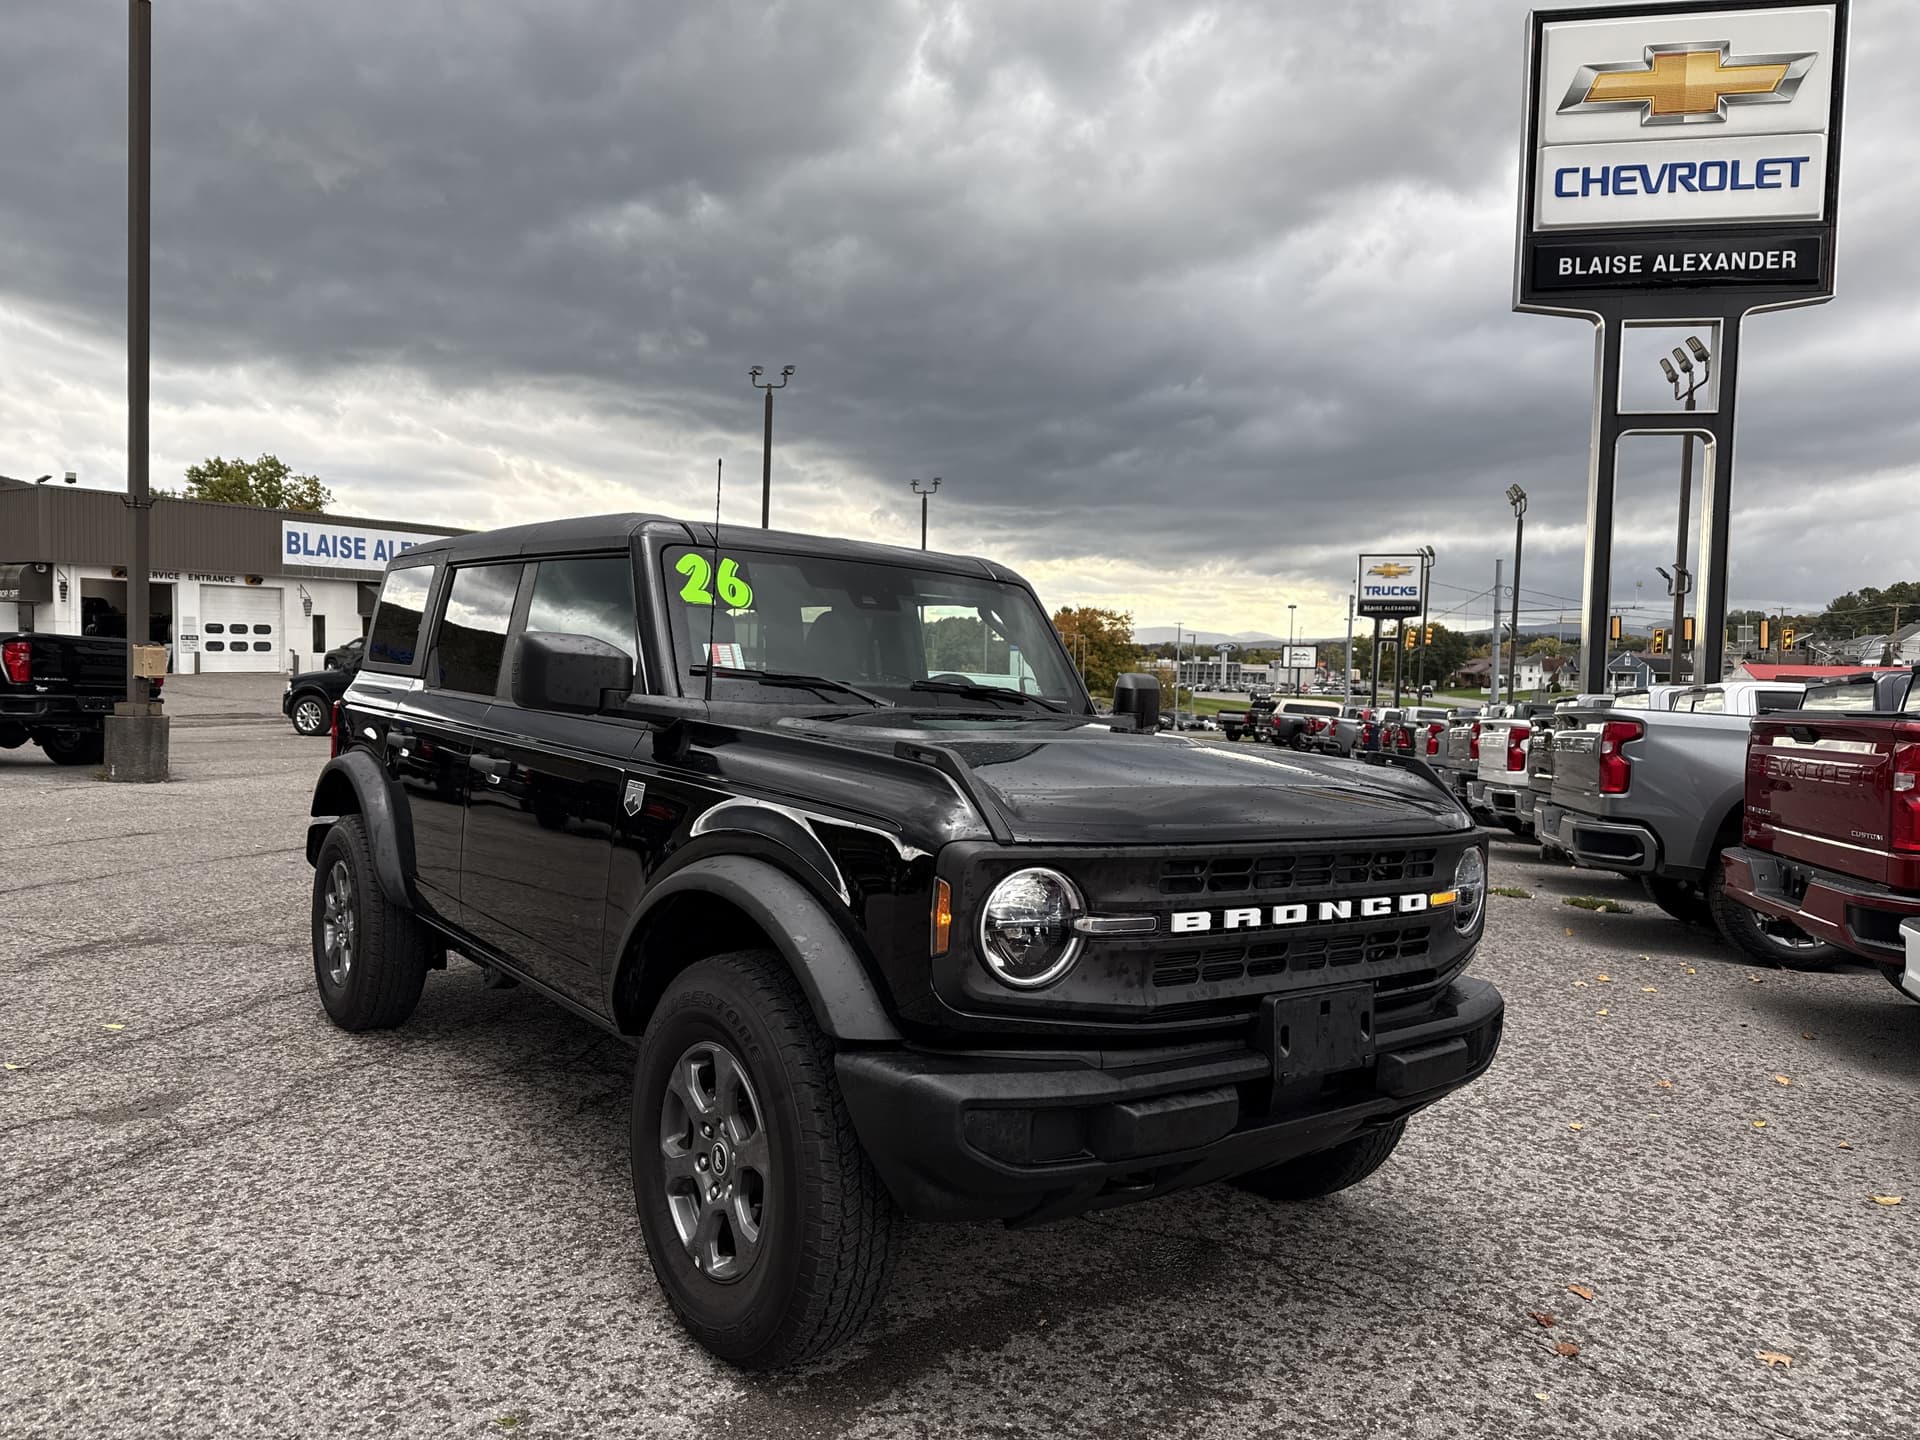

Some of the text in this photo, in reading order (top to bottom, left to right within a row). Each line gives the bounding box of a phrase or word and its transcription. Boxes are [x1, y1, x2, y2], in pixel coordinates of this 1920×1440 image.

[1555, 156, 1810, 198] CHEVROLET
[1558, 250, 1798, 276] BLAISE ALEXANDER
[286, 530, 366, 560] BLAISE
[187, 573, 236, 583] ENTRANCE
[675, 553, 753, 609] 26
[1364, 586, 1418, 596] TRUCKS
[1851, 830, 1884, 841] CUSTOM
[1171, 894, 1427, 932] BRONCO
